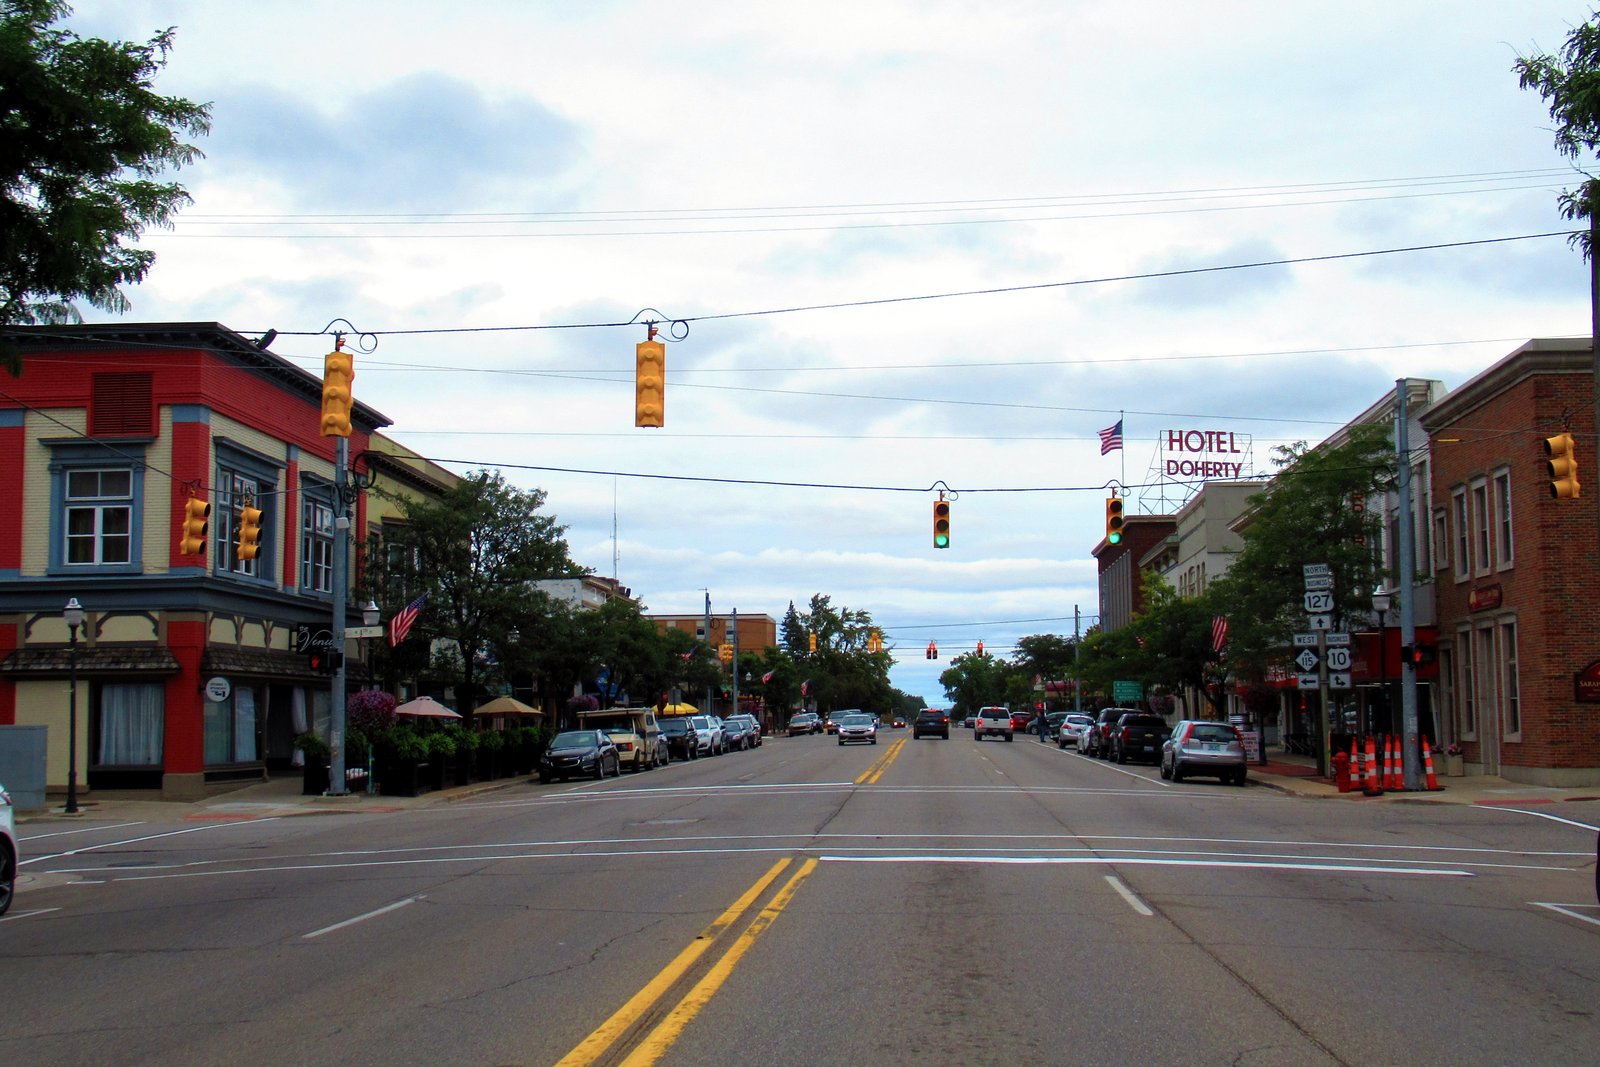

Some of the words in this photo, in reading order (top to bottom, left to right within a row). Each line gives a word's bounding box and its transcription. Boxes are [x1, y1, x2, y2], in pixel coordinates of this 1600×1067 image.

[1168, 430, 1241, 453] HOTEL
[1166, 459, 1242, 479] DOHERTY
[1304, 565, 1327, 574] NORTH
[1307, 595, 1330, 609] 127
[298, 629, 336, 652] Venu
[1327, 635, 1348, 643] BUSINESS
[1302, 656, 1314, 667] 115
[1331, 652, 1347, 666] 10
